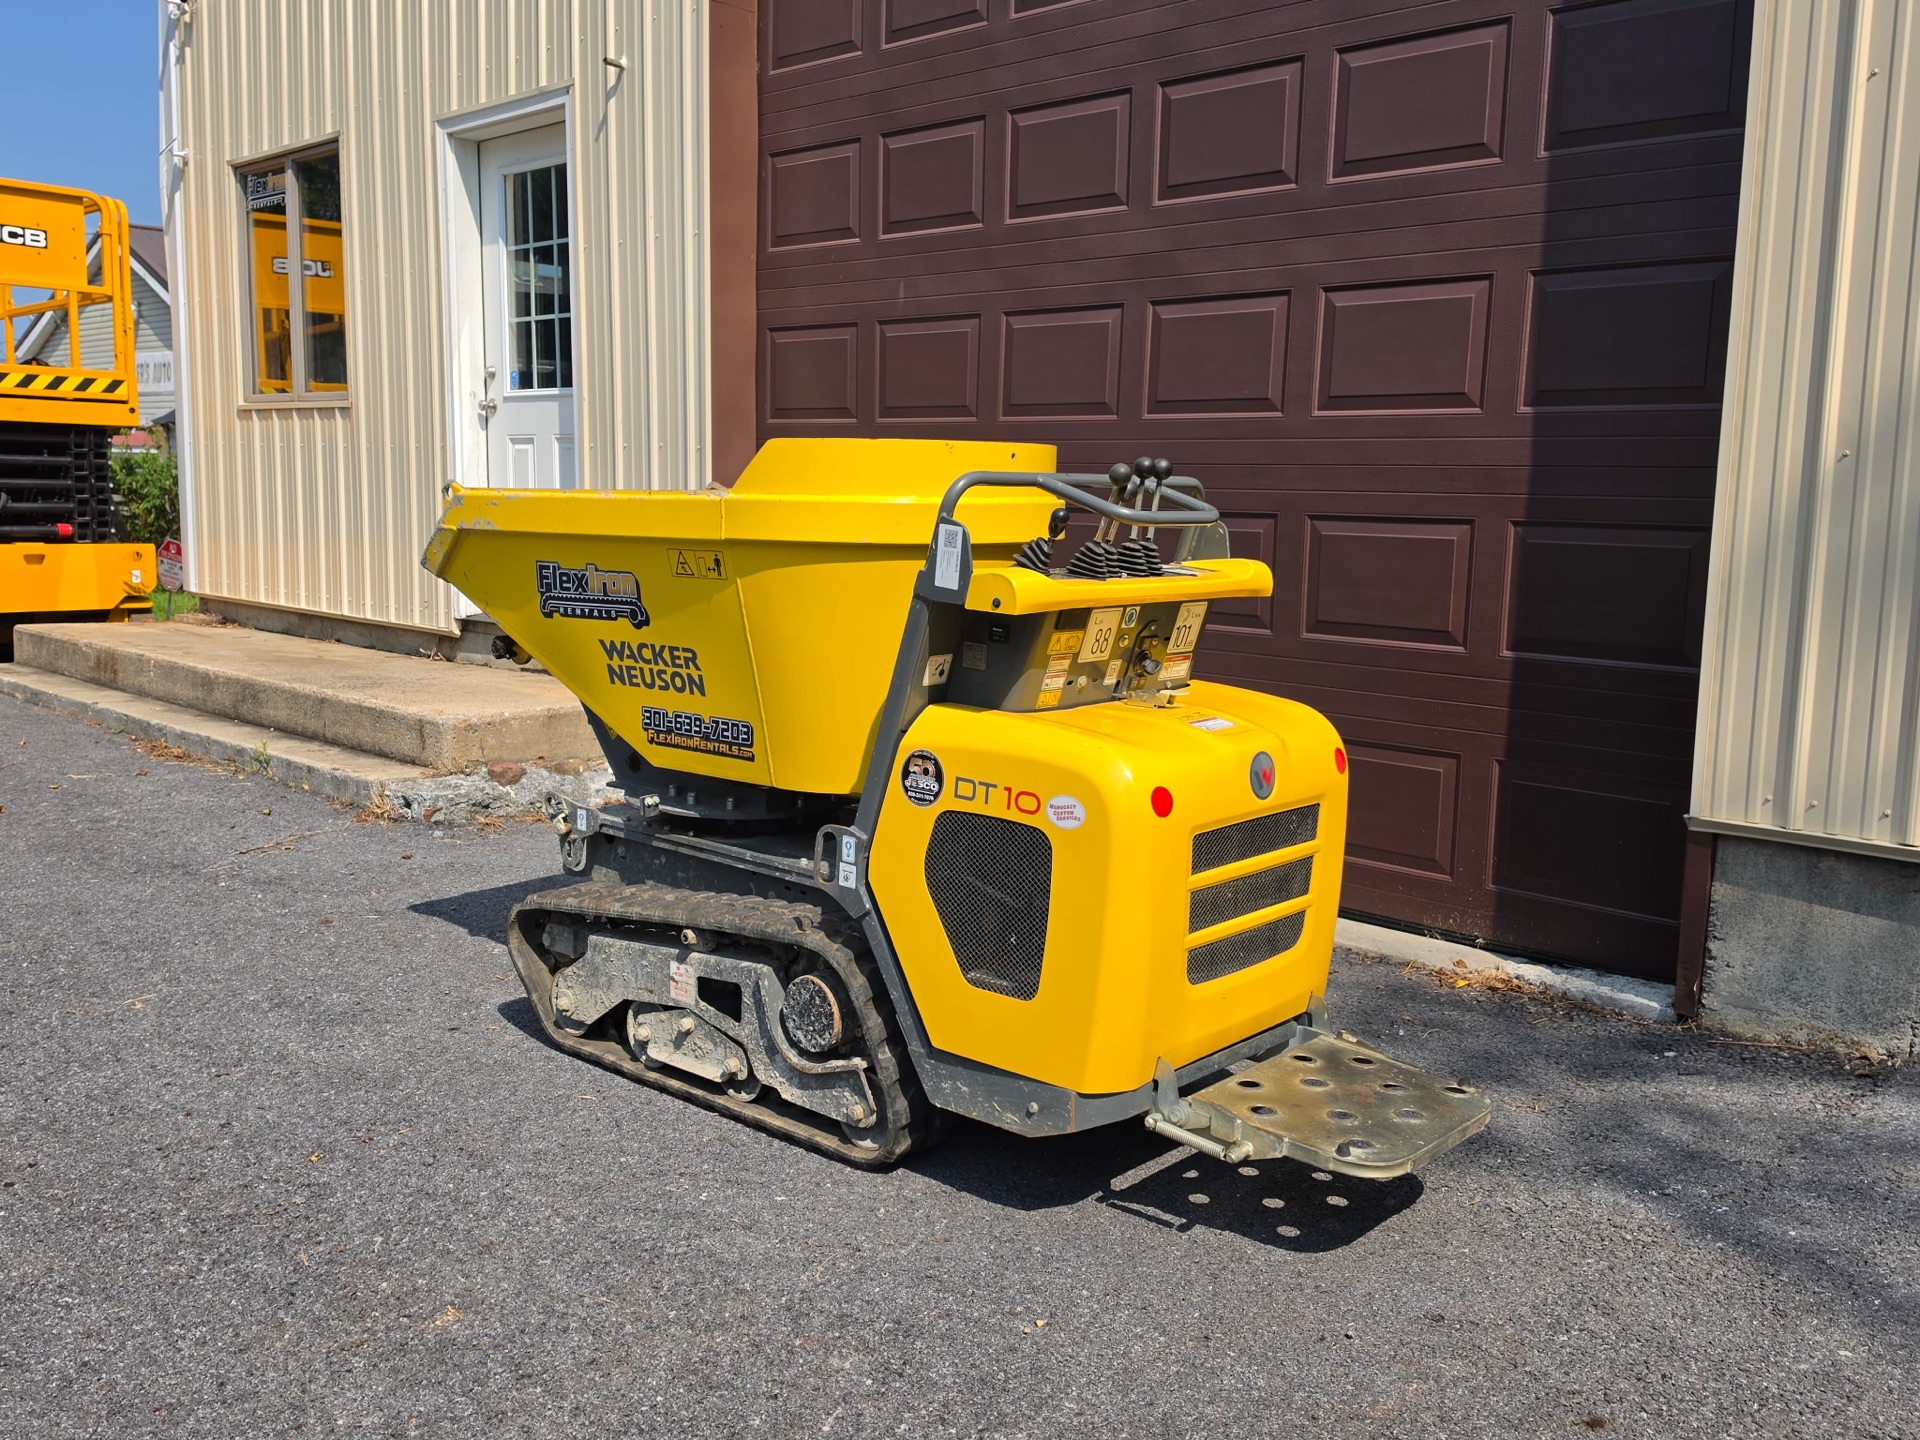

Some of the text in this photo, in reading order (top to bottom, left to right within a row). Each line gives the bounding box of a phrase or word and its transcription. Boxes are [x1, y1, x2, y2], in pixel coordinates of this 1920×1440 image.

[0, 225, 47, 248] CB
[538, 562, 638, 598] FlexIron
[560, 606, 616, 618] RENTALS
[1091, 627, 1111, 654] 88
[1172, 624, 1193, 648] 101
[598, 639, 702, 671] WACKER
[607, 664, 706, 697] NEUSON
[643, 707, 752, 744] 301-639-7203
[905, 779, 939, 792] JESCO
[954, 776, 1042, 816] DT 10
